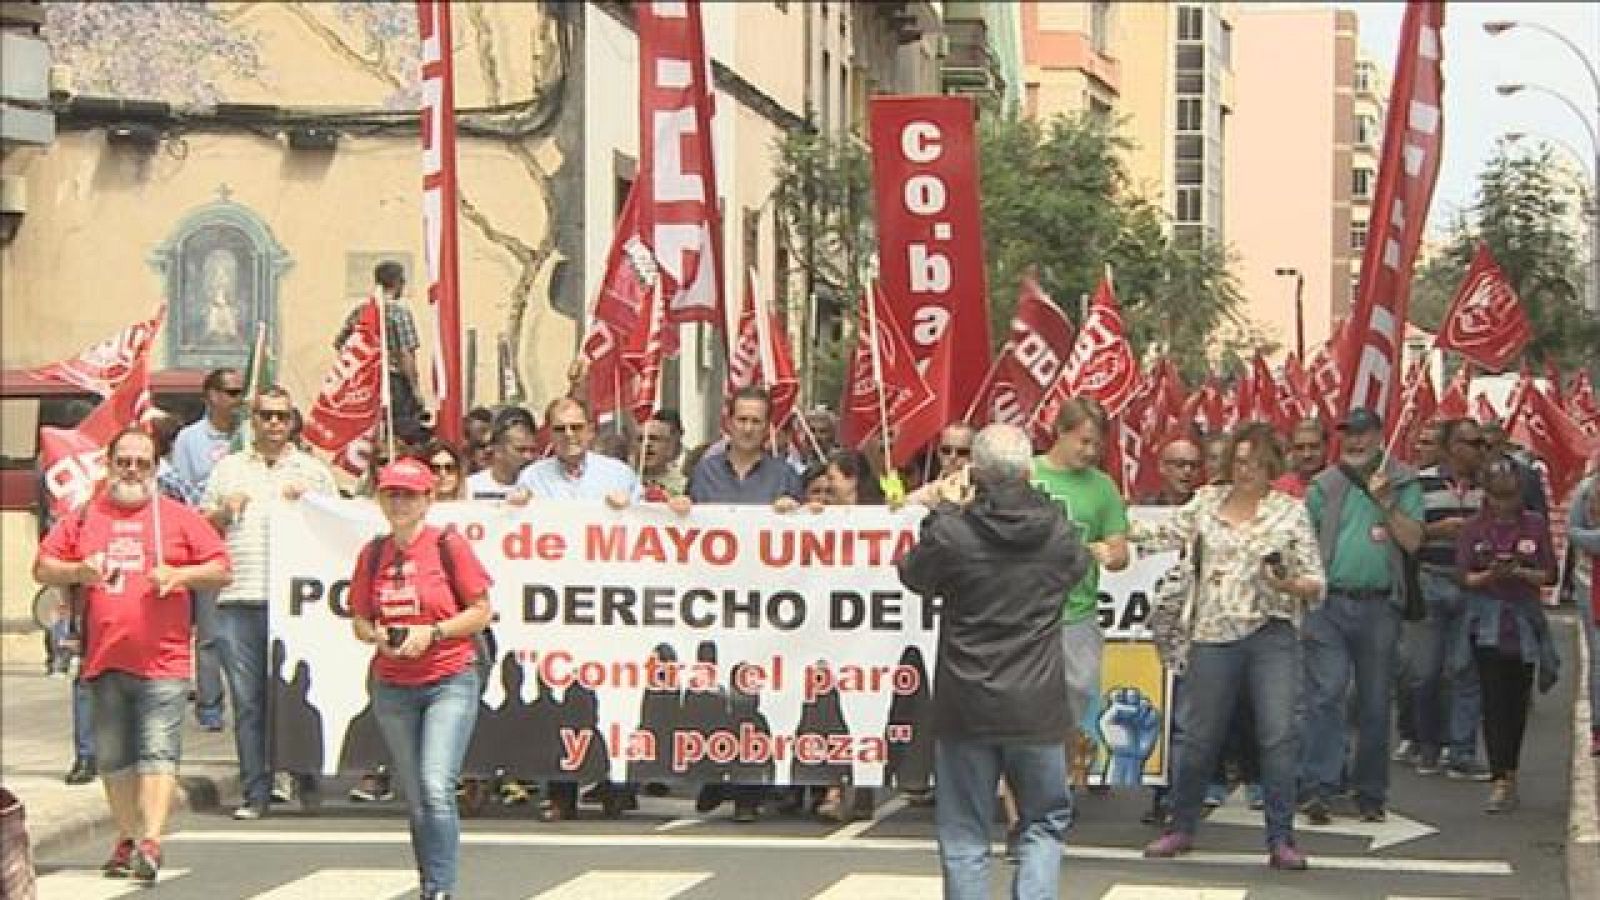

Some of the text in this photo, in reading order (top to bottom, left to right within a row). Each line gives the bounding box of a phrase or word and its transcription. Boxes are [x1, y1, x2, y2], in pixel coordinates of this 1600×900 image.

[902, 121, 951, 374] co.ba
[503, 523, 566, 560] de
[586, 525, 738, 566] MAYO
[759, 530, 915, 567] UNITA
[523, 584, 806, 630] DERECHO
[829, 590, 901, 631] DE
[735, 656, 782, 691] el
[804, 662, 921, 701] paro
[561, 728, 591, 772] y
[612, 724, 655, 762] la
